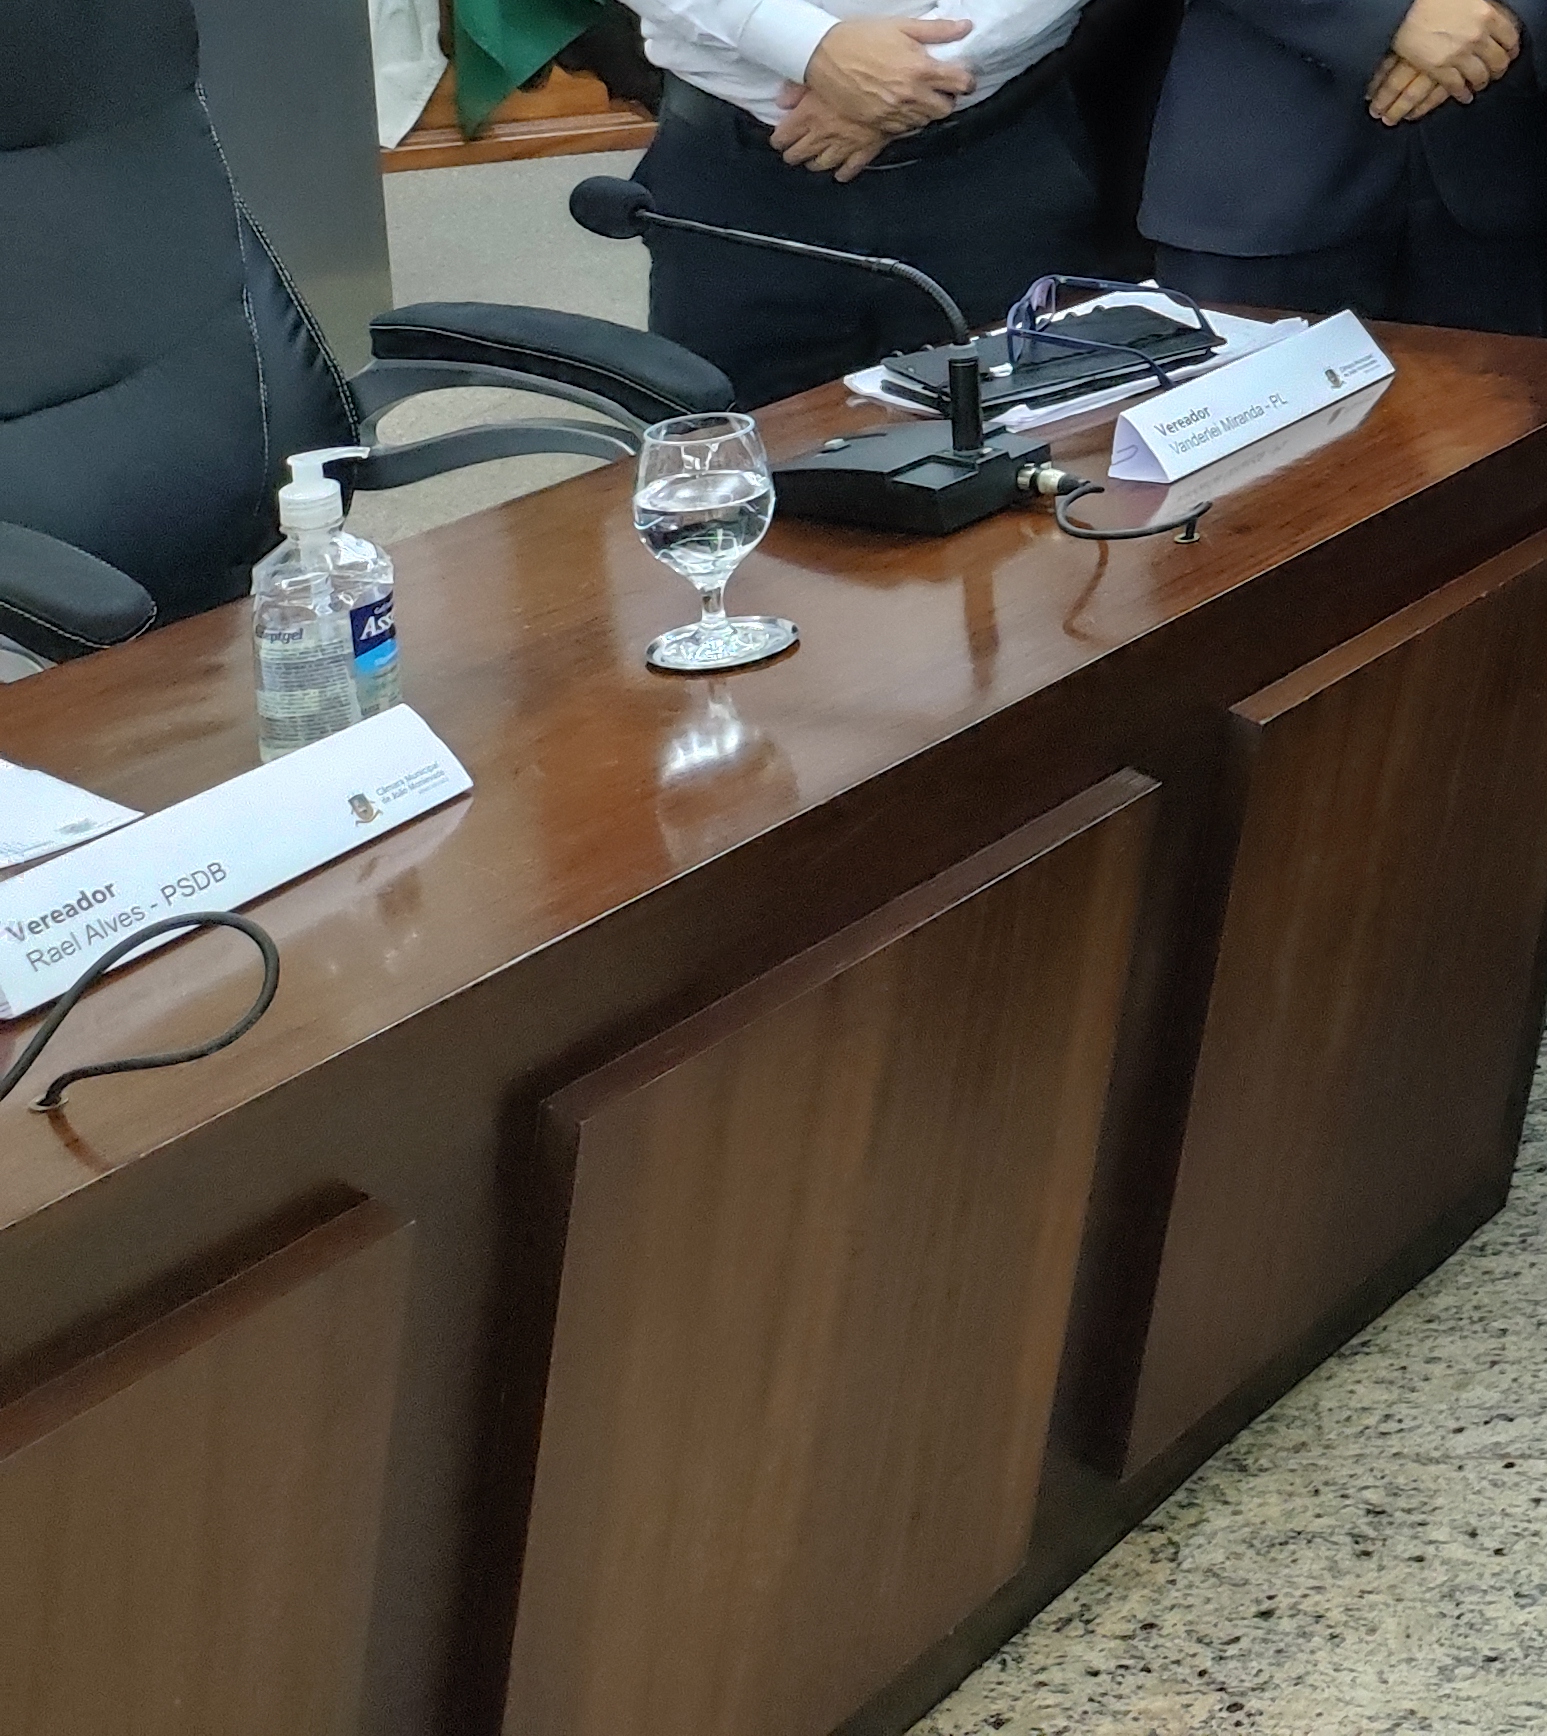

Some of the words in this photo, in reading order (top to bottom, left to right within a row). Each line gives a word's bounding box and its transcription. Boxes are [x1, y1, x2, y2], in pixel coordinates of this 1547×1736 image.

[1154, 406, 1211, 436] Vereador
[1168, 424, 1222, 455] Vanderlei
[1219, 404, 1265, 432] Miranda
[1269, 393, 1288, 410] PL
[5, 882, 116, 942] Vereador
[25, 931, 82, 973] Rael
[86, 905, 146, 946] Alves
[160, 862, 228, 907] PSDB
